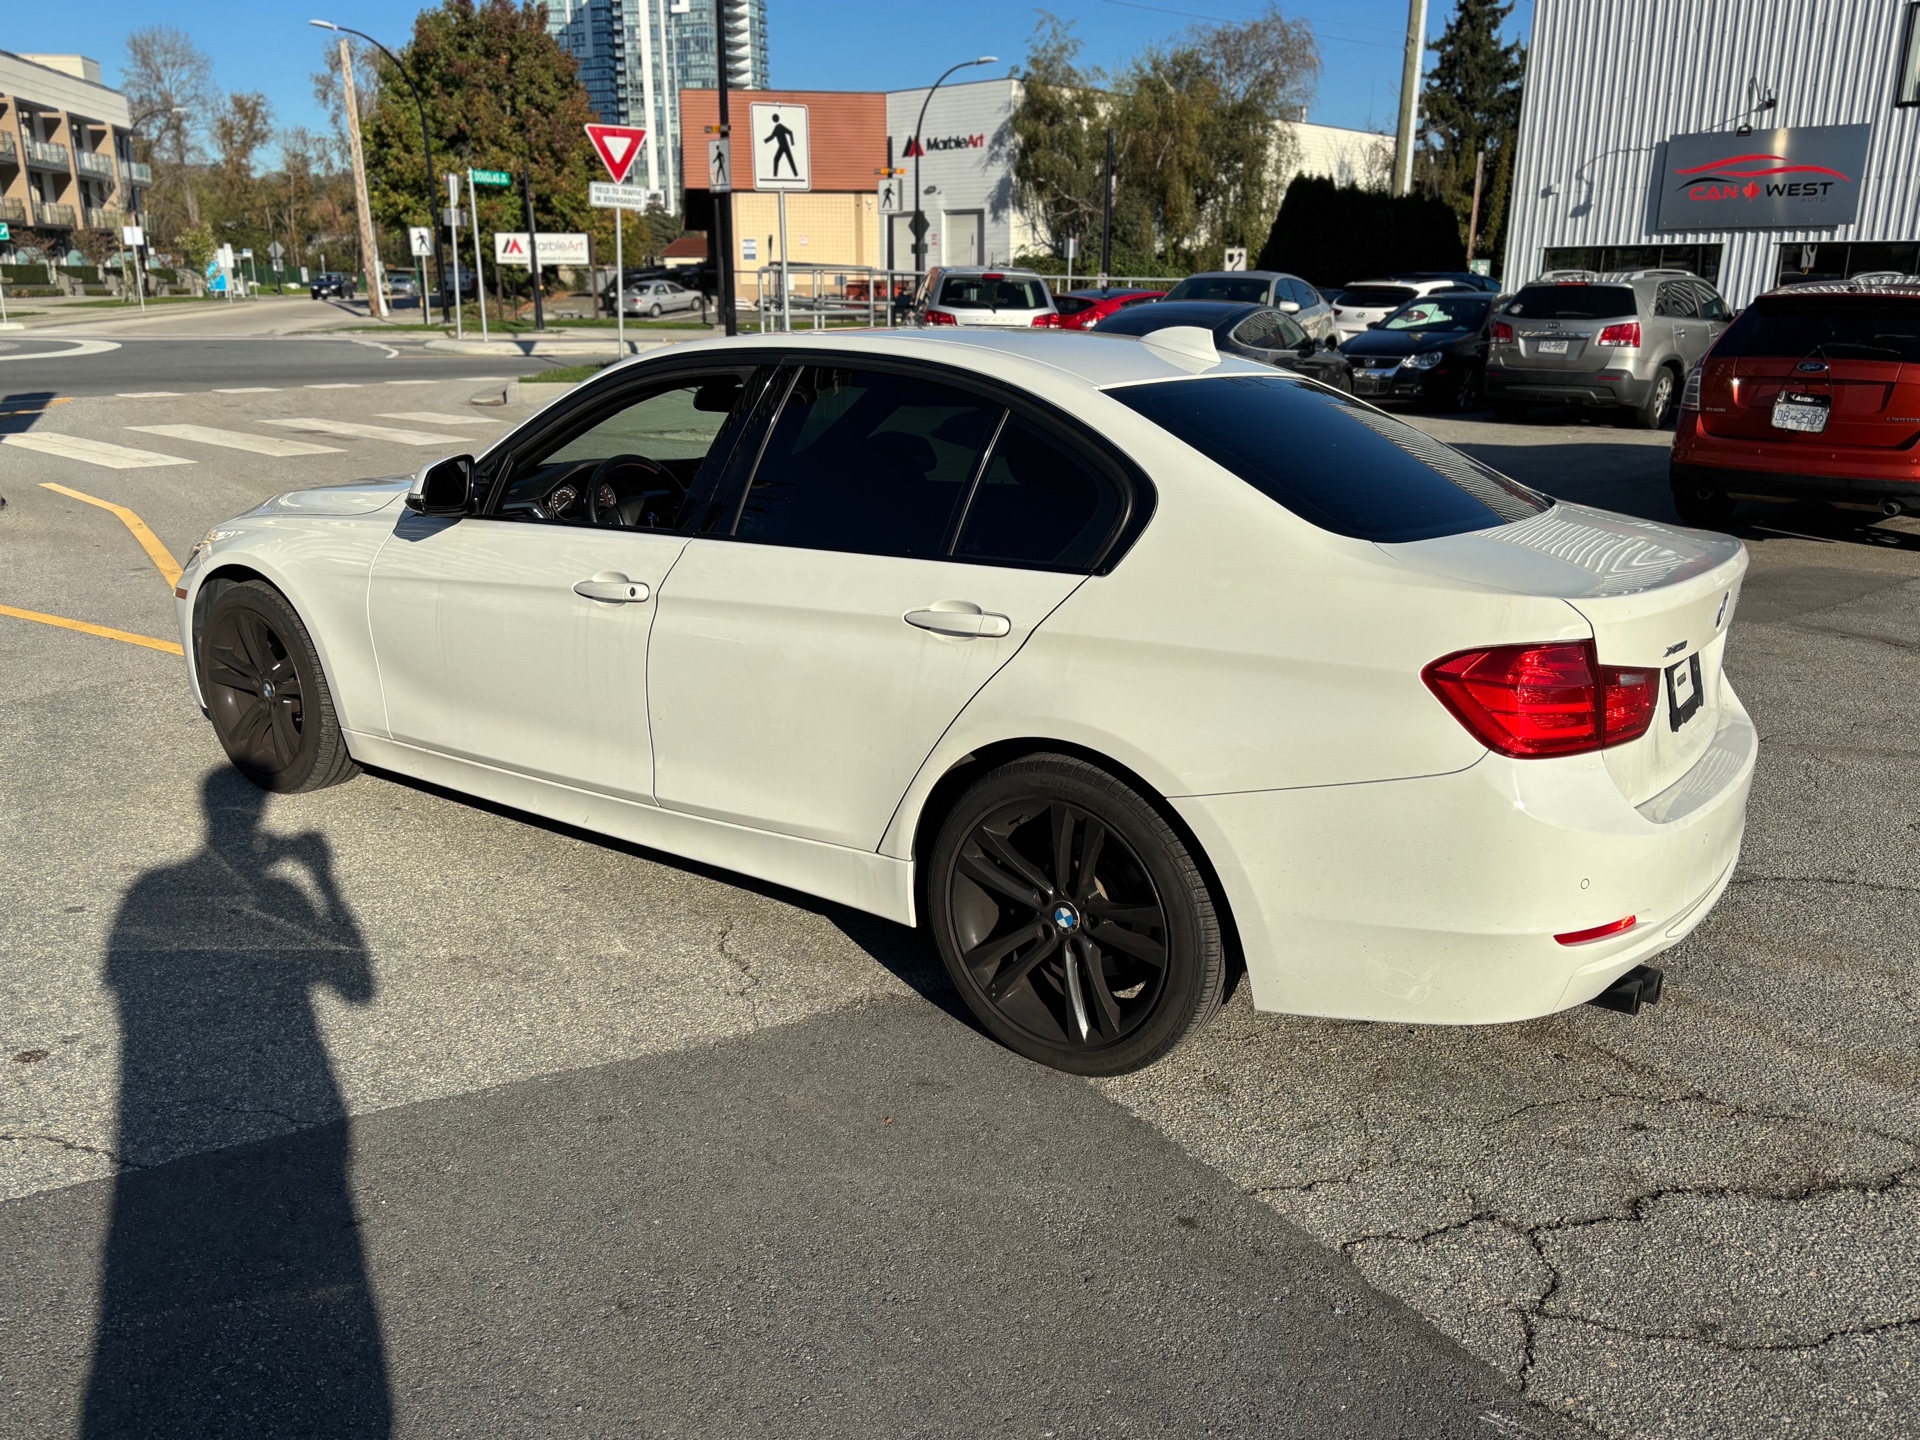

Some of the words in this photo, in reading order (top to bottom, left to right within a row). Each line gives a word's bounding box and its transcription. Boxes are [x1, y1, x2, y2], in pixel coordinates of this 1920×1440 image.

[926, 134, 984, 151] MarbleArt
[474, 171, 500, 183] DOUGLAS
[621, 188, 642, 197] TRAFFIC
[1689, 186, 1739, 201] CAN
[1765, 182, 1834, 197] WEST
[603, 196, 642, 206] ROUNDABOUT
